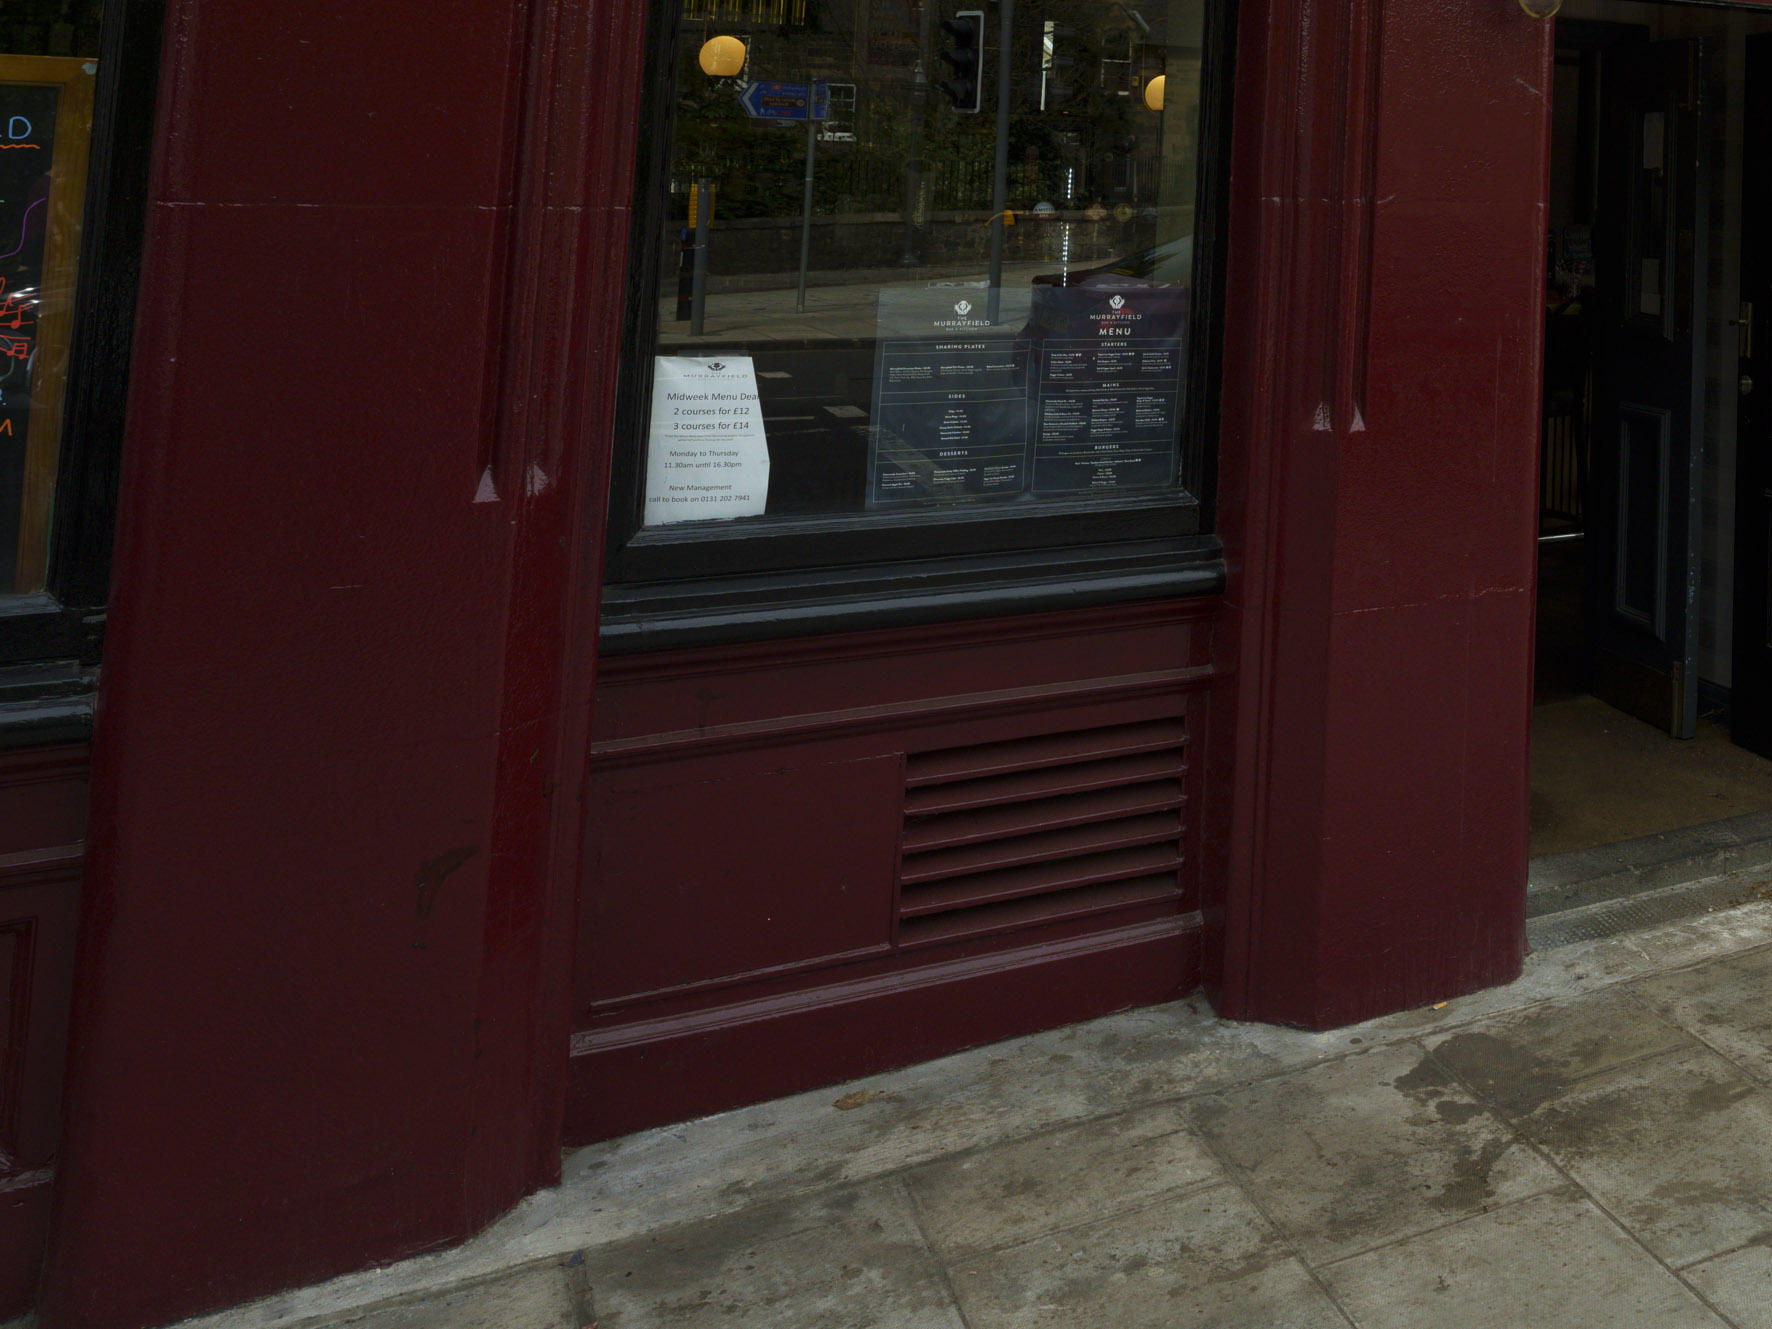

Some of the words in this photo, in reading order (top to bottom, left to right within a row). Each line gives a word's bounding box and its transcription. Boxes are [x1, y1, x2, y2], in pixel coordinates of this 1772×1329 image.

[1098, 328, 1132, 336] MENU
[667, 392, 709, 401] Midweek
[711, 392, 738, 401] Menu
[673, 408, 680, 416] 2
[718, 407, 731, 415] for
[733, 407, 750, 415] £12
[673, 422, 679, 430] 3
[718, 422, 731, 430] for
[733, 422, 749, 430] £14
[669, 450, 698, 458] Monday
[695, 461, 711, 469] until
[713, 461, 742, 469] 16.30pm
[686, 484, 732, 493] Management
[700, 495, 717, 503] 0131
[734, 494, 750, 502] 7941
